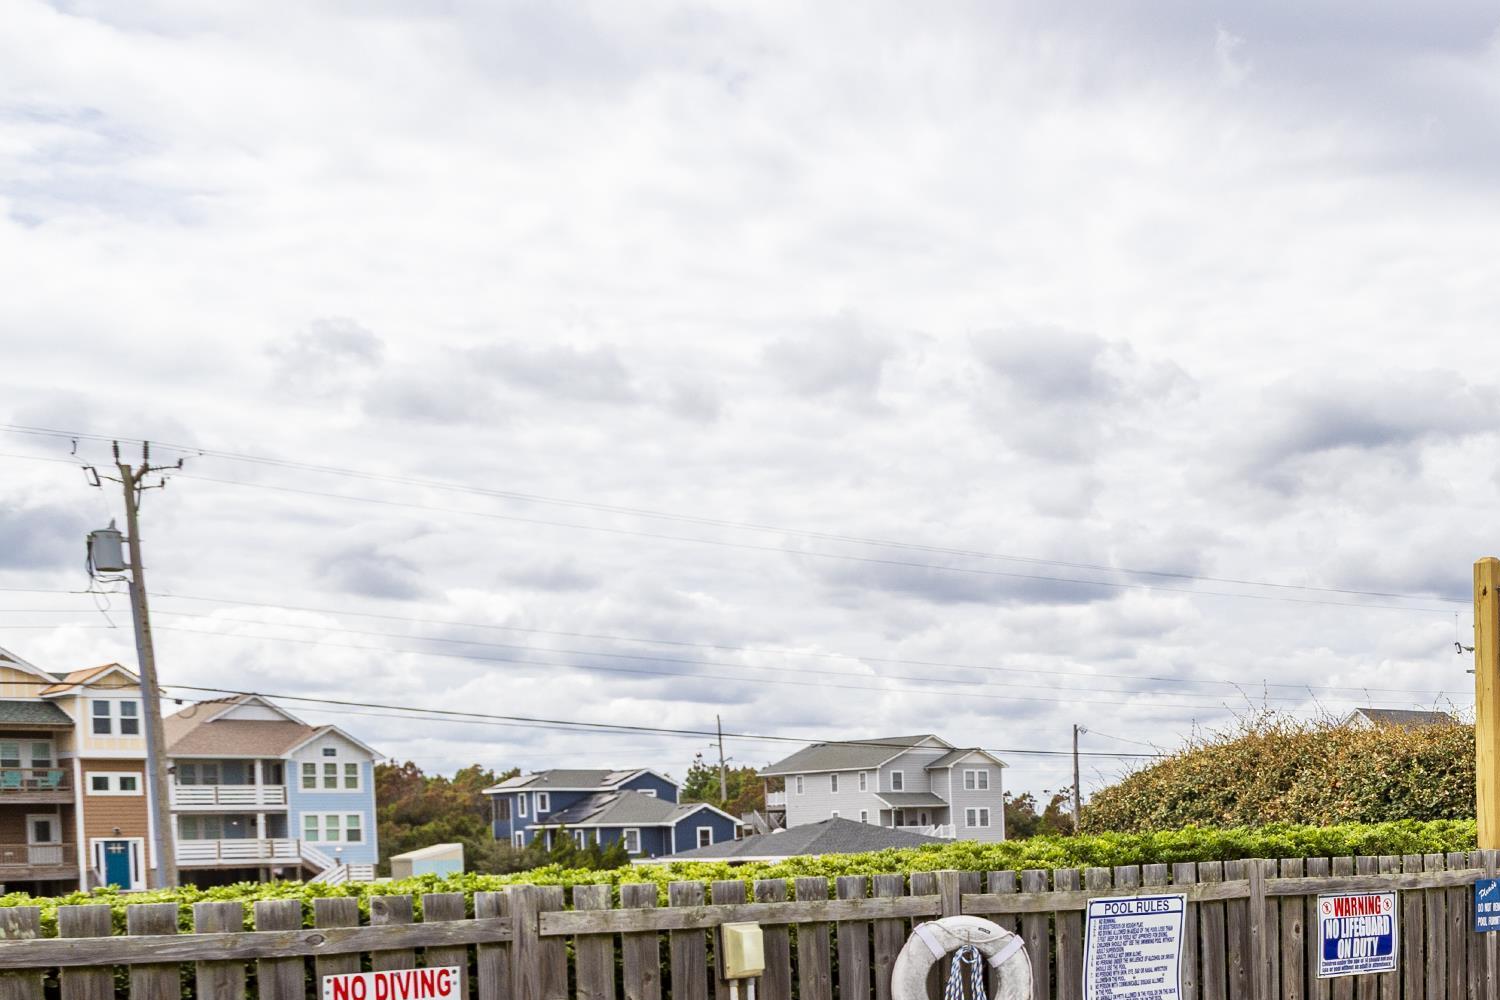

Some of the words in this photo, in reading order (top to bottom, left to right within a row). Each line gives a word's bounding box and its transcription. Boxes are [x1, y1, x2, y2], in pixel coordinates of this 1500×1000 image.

[1104, 902, 1132, 914] POOL
[1136, 900, 1169, 912] RULES
[1334, 895, 1381, 917] WARNING
[1478, 903, 1484, 912] DO
[1484, 902, 1492, 912] NOT
[1326, 919, 1340, 940] NO
[1341, 916, 1390, 938] LIFEGUARD
[1478, 916, 1488, 926] POOL
[1338, 938, 1352, 959] ON
[1353, 936, 1379, 957] DUTY
